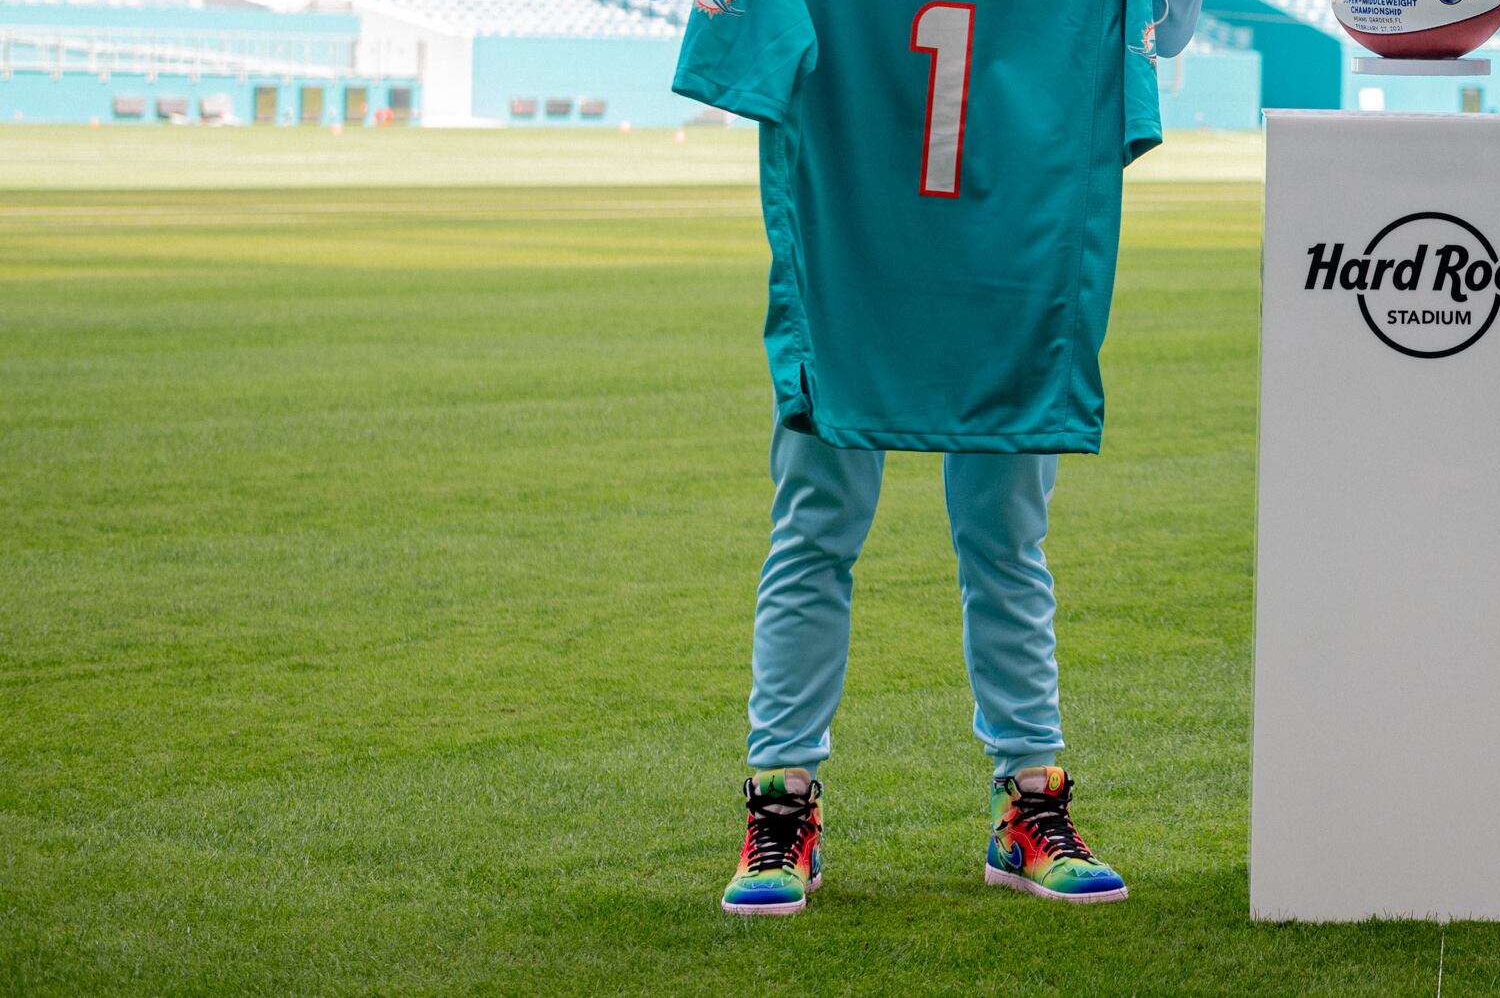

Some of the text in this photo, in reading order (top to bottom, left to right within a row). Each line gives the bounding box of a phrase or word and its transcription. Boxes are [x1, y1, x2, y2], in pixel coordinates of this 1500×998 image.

[1351, 6, 1402, 16] CHAMPIONSHIP
[910, 1, 977, 199] 1
[1304, 243, 1428, 291] Hard
[1387, 310, 1472, 325] STADIUM
